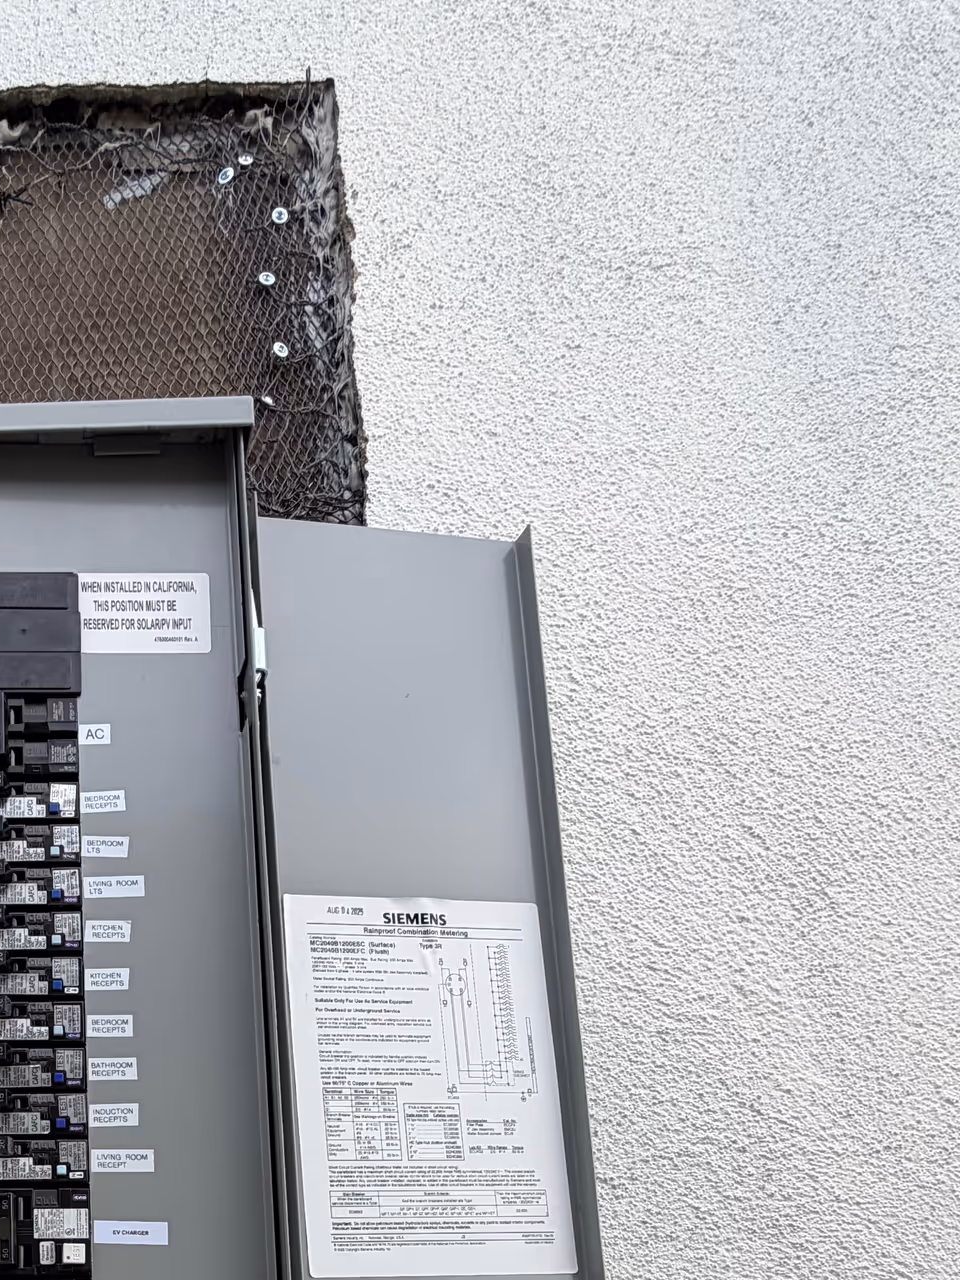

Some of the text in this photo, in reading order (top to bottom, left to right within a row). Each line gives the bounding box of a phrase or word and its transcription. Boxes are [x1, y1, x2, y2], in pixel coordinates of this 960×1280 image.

[81, 581, 197, 594] WHEN INSTALLED IN CALIFORNIA,
[93, 600, 177, 612] THIS POSITION MUST BE
[84, 618, 192, 630] RESERVED FOR SOLAR/PV INPUT
[86, 728, 105, 740] AC
[84, 794, 121, 803] BEDROOM
[85, 802, 118, 810] RECEPTS
[86, 840, 124, 848] BEDROOM
[327, 906, 340, 914] AUG
[383, 912, 447, 926] SIEMENS
[364, 927, 468, 938] Rainproof Combination Metering
[0, 1140, 6, 1149] 20
[2, 1200, 8, 1210] 50
[2, 1248, 9, 1258] 50
